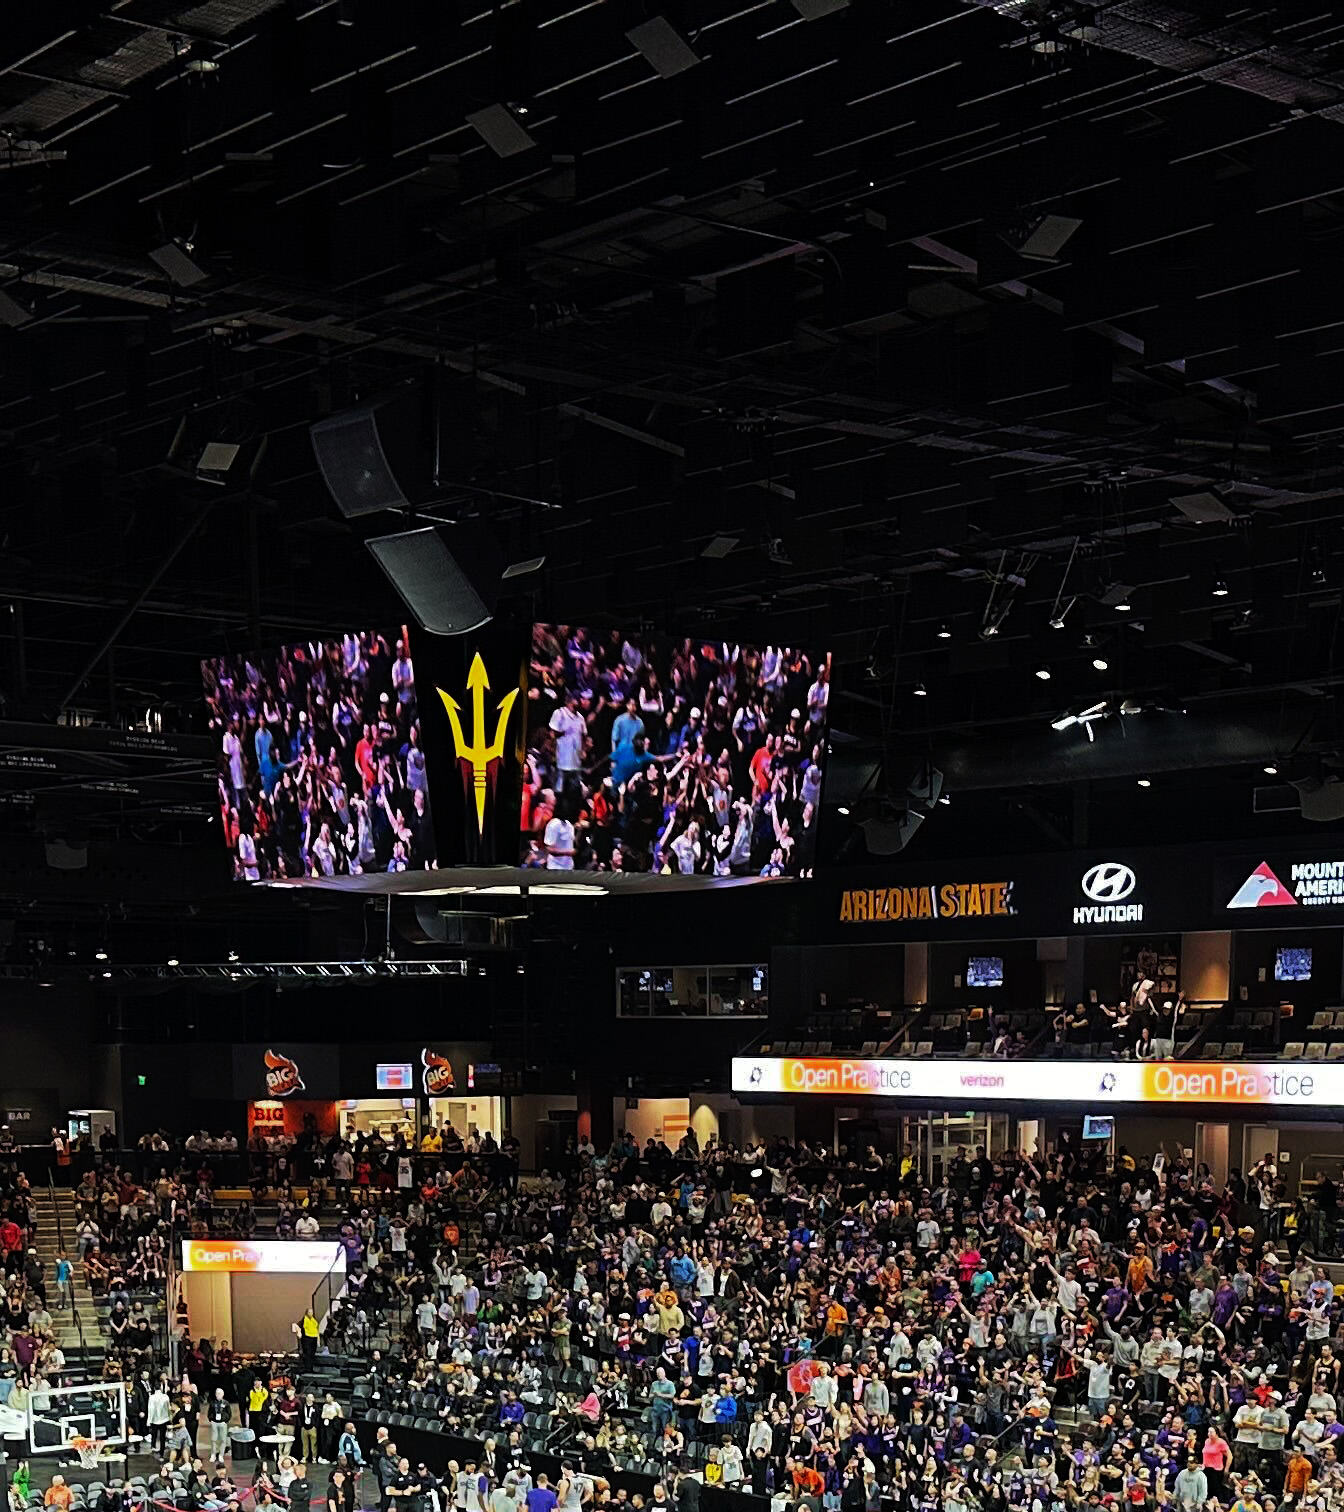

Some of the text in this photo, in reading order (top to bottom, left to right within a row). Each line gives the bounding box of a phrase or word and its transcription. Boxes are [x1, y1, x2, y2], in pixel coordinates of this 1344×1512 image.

[839, 882, 1011, 922] ARIZONA STATE
[1073, 904, 1143, 924] HYUNDAI
[266, 1067, 292, 1087] BIG
[426, 1065, 448, 1086] BIG
[790, 1062, 911, 1090] Open Practice
[959, 1072, 1005, 1088] verizon
[1154, 1067, 1314, 1097] Open Practice
[254, 1107, 284, 1121] BIG
[193, 1248, 231, 1264] Open
